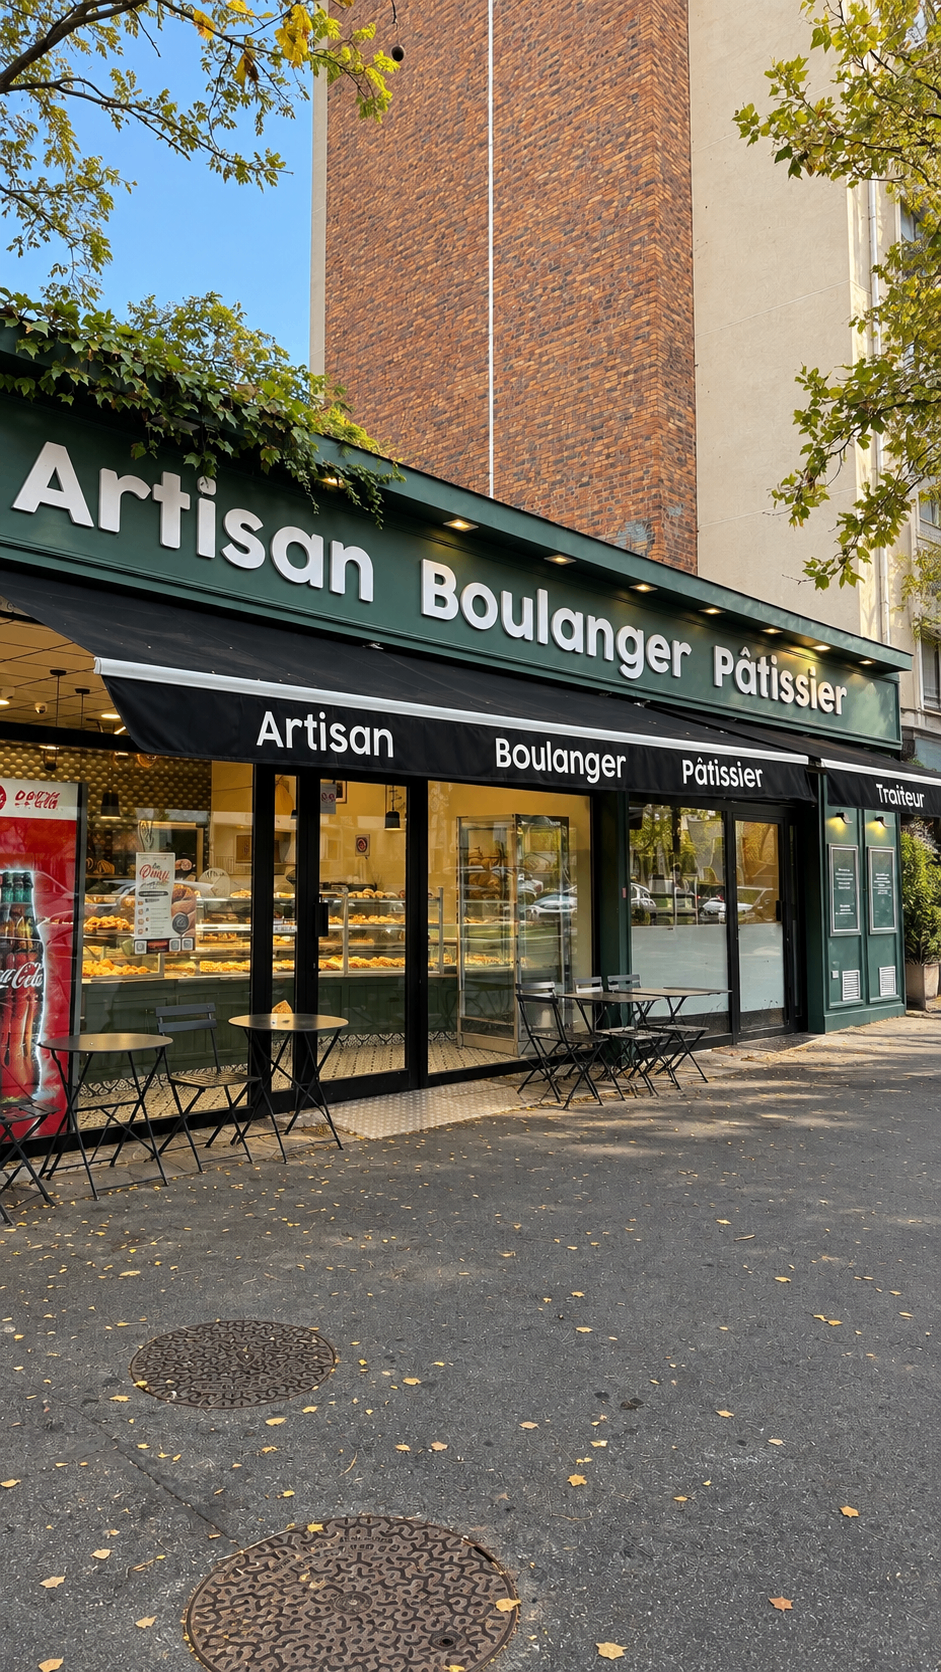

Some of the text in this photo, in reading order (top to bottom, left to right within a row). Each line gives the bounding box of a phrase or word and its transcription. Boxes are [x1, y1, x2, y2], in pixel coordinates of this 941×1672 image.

[12, 441, 848, 716] Artisan Boulanger Pâtissier
[257, 711, 764, 788] Artisan Boulanger Pâtissier
[875, 783, 925, 808] Traiteur
